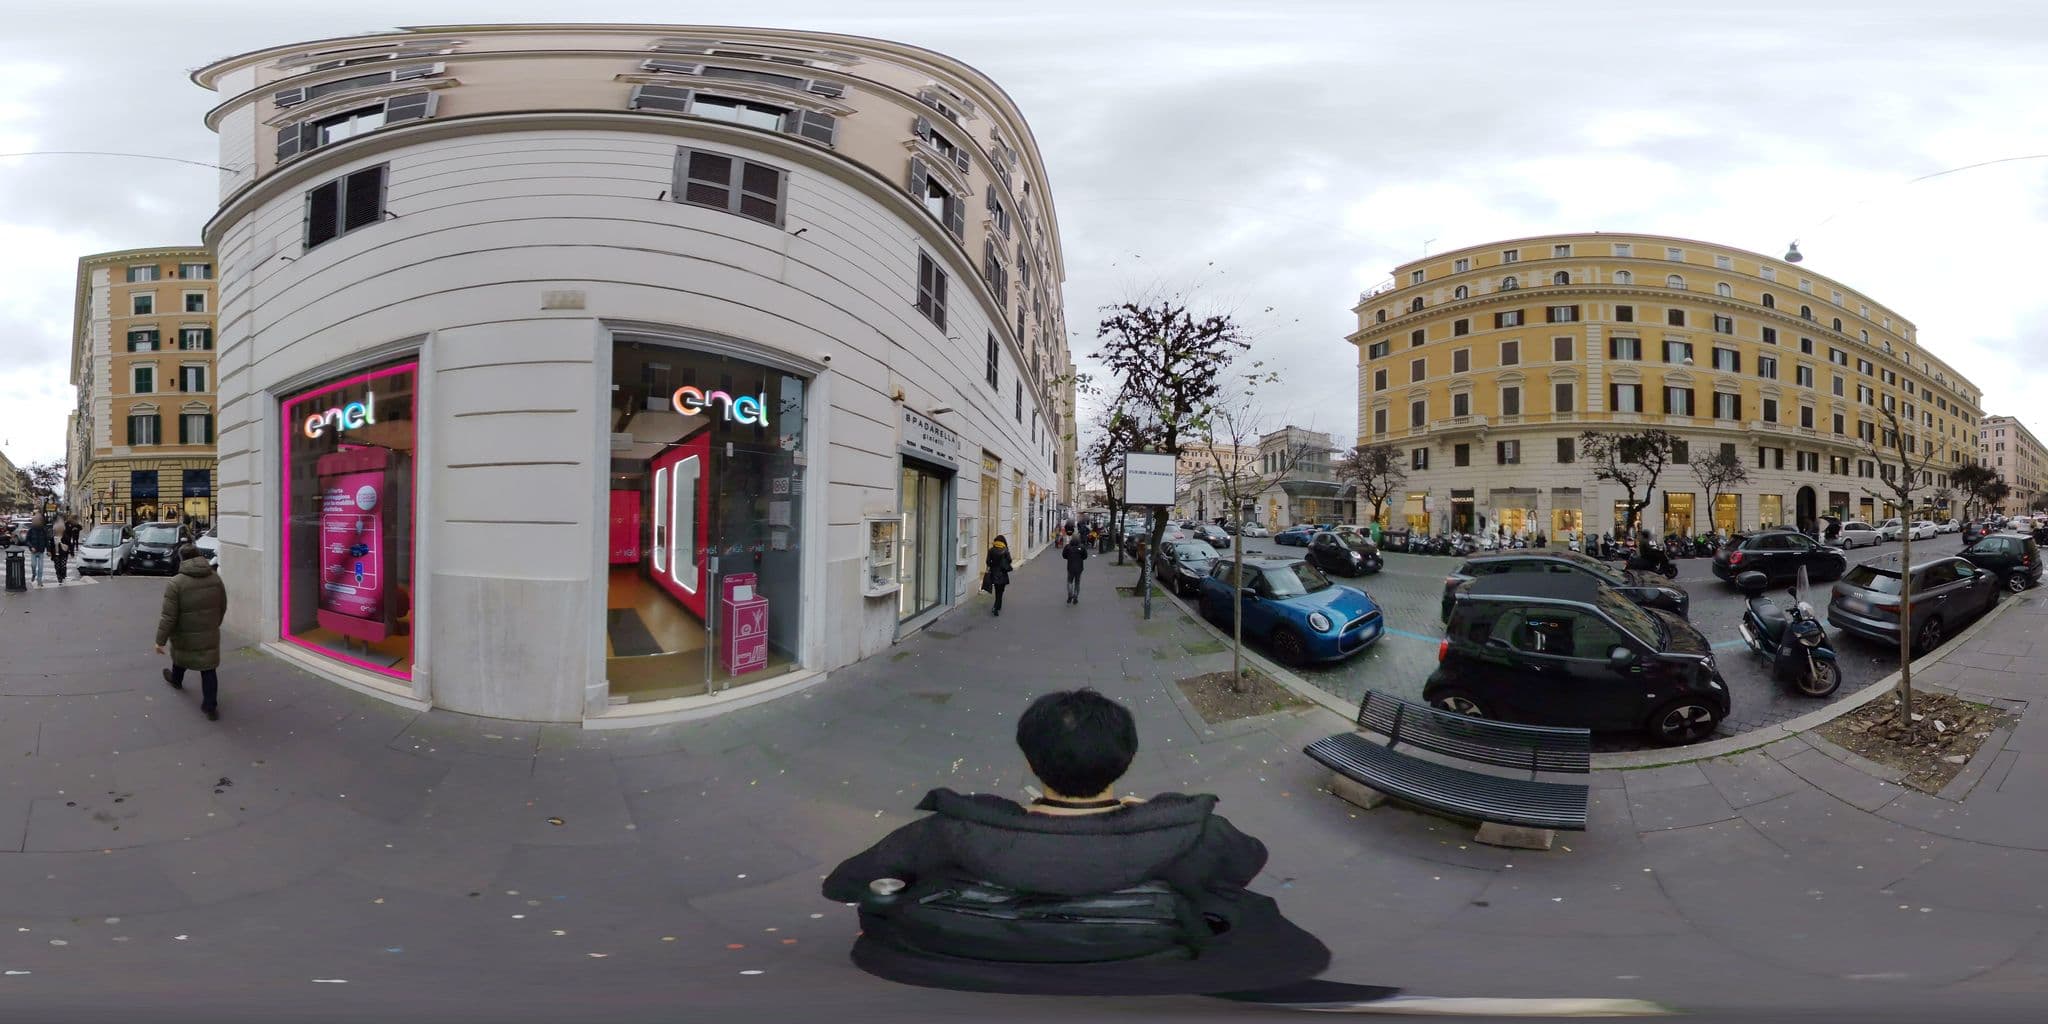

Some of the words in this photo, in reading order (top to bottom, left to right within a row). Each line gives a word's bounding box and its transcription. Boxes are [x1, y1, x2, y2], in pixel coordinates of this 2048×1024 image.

[304, 391, 375, 439] enel
[672, 385, 769, 428] enel
[905, 414, 956, 443] SPADARELLA
